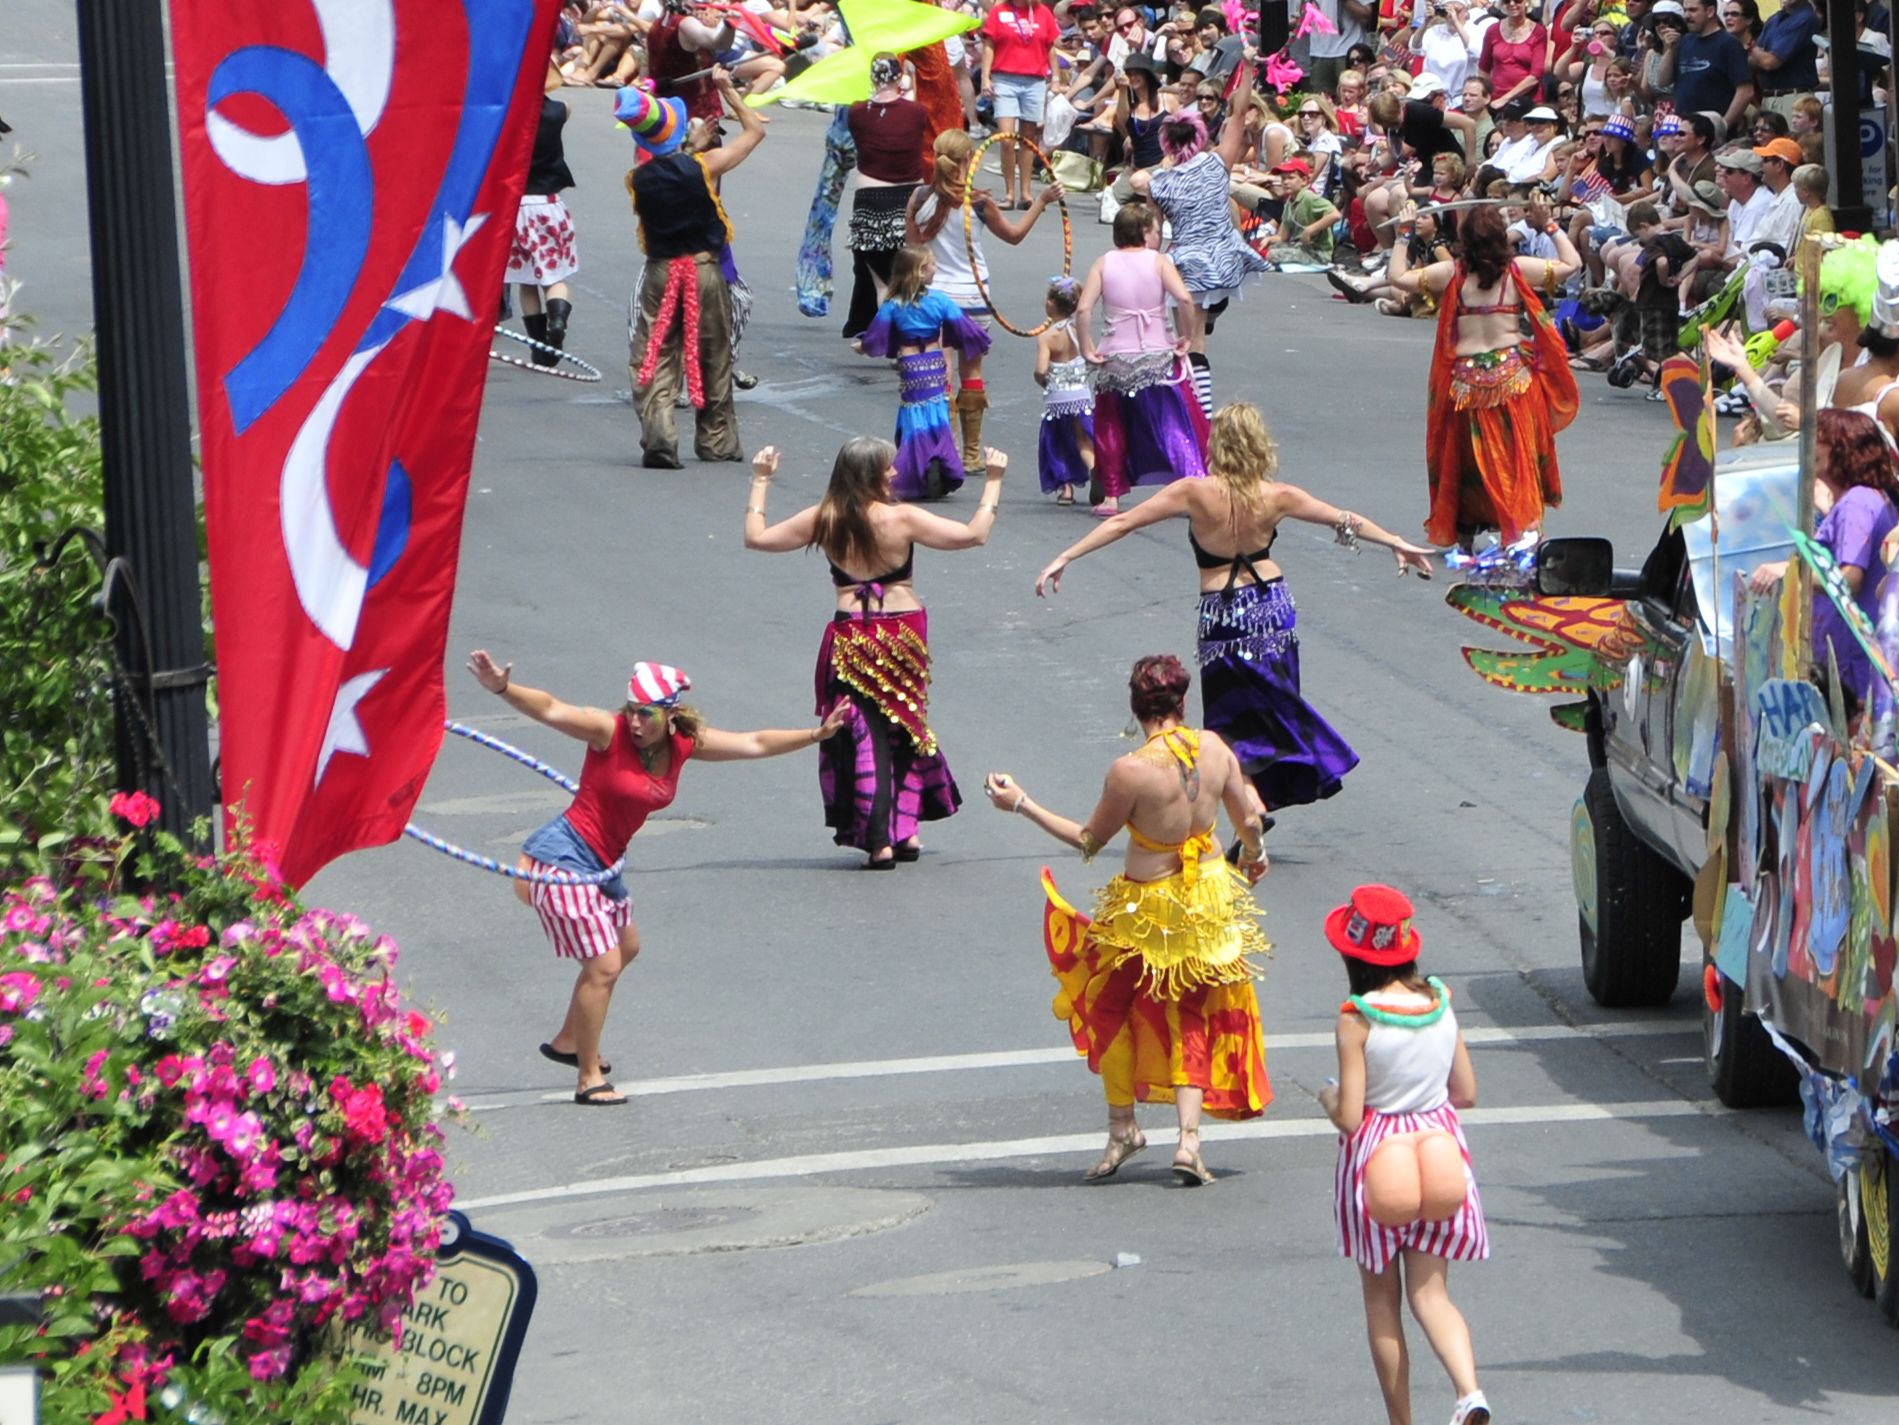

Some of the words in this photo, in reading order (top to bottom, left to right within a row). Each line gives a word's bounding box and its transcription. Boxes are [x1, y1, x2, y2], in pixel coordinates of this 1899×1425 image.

[440, 1276, 468, 1306] TO
[400, 1302, 451, 1333] ARK
[402, 1329, 480, 1374] BLOCK
[416, 1373, 467, 1408] 8PM
